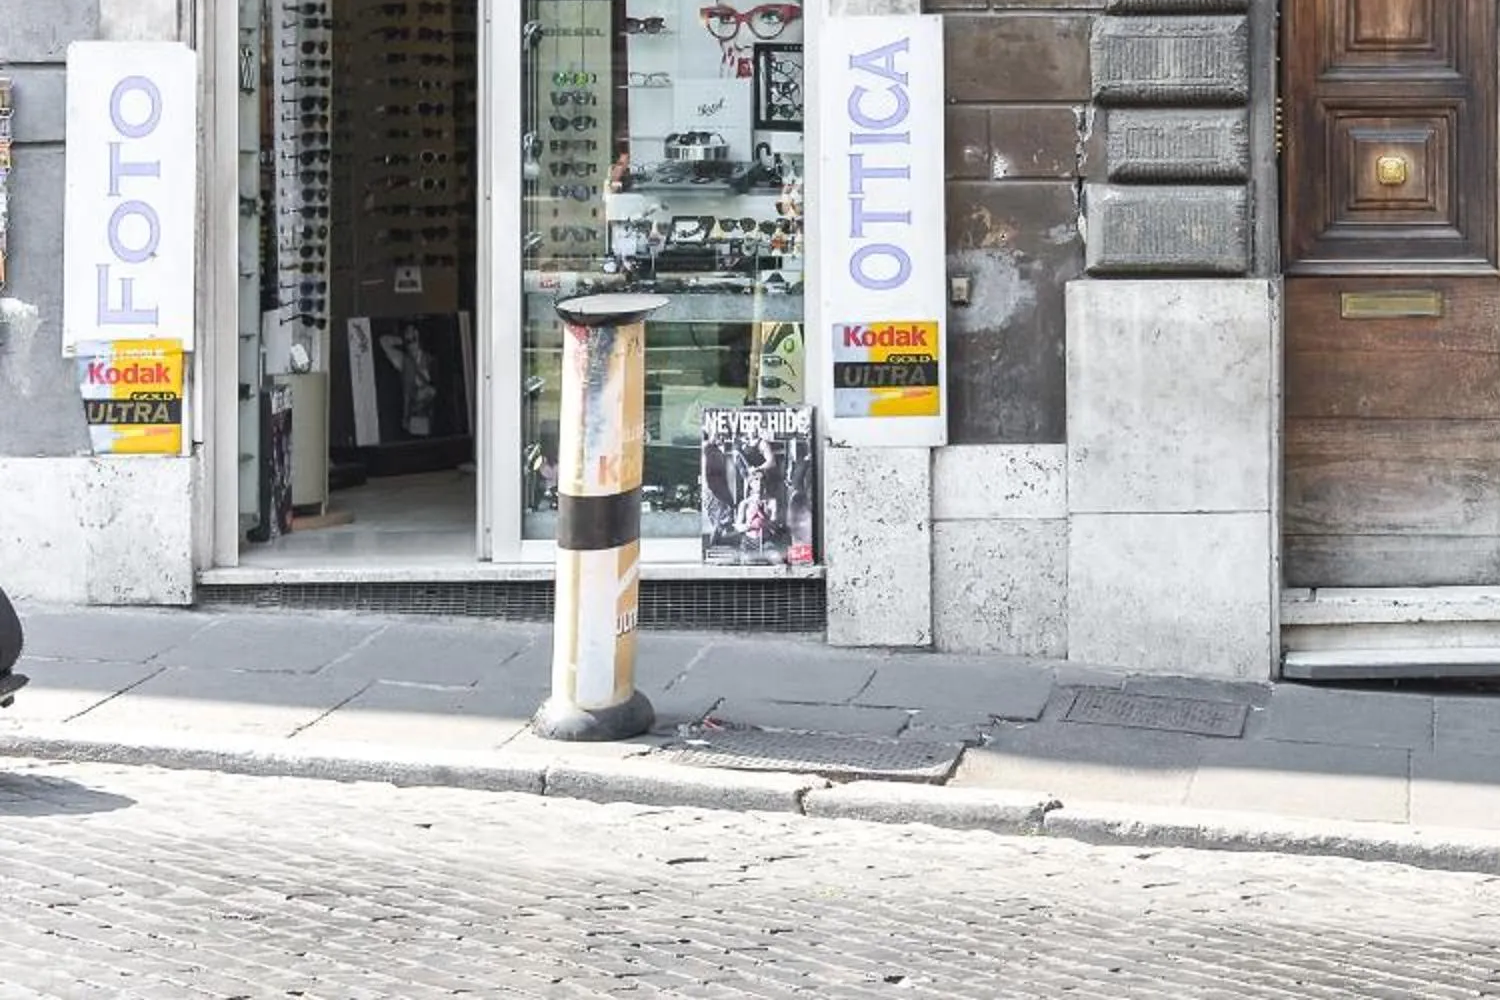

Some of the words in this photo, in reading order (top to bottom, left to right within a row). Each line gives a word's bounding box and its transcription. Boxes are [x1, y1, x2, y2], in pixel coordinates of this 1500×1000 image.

[847, 36, 912, 291] OTTICA
[96, 75, 163, 327] FOTO
[844, 325, 928, 347] Kodak
[889, 355, 931, 364] GOLD
[87, 361, 171, 385] Kodak
[844, 365, 928, 387] ULTRA
[87, 402, 171, 423] ULTRA
[703, 409, 761, 434] NEVER
